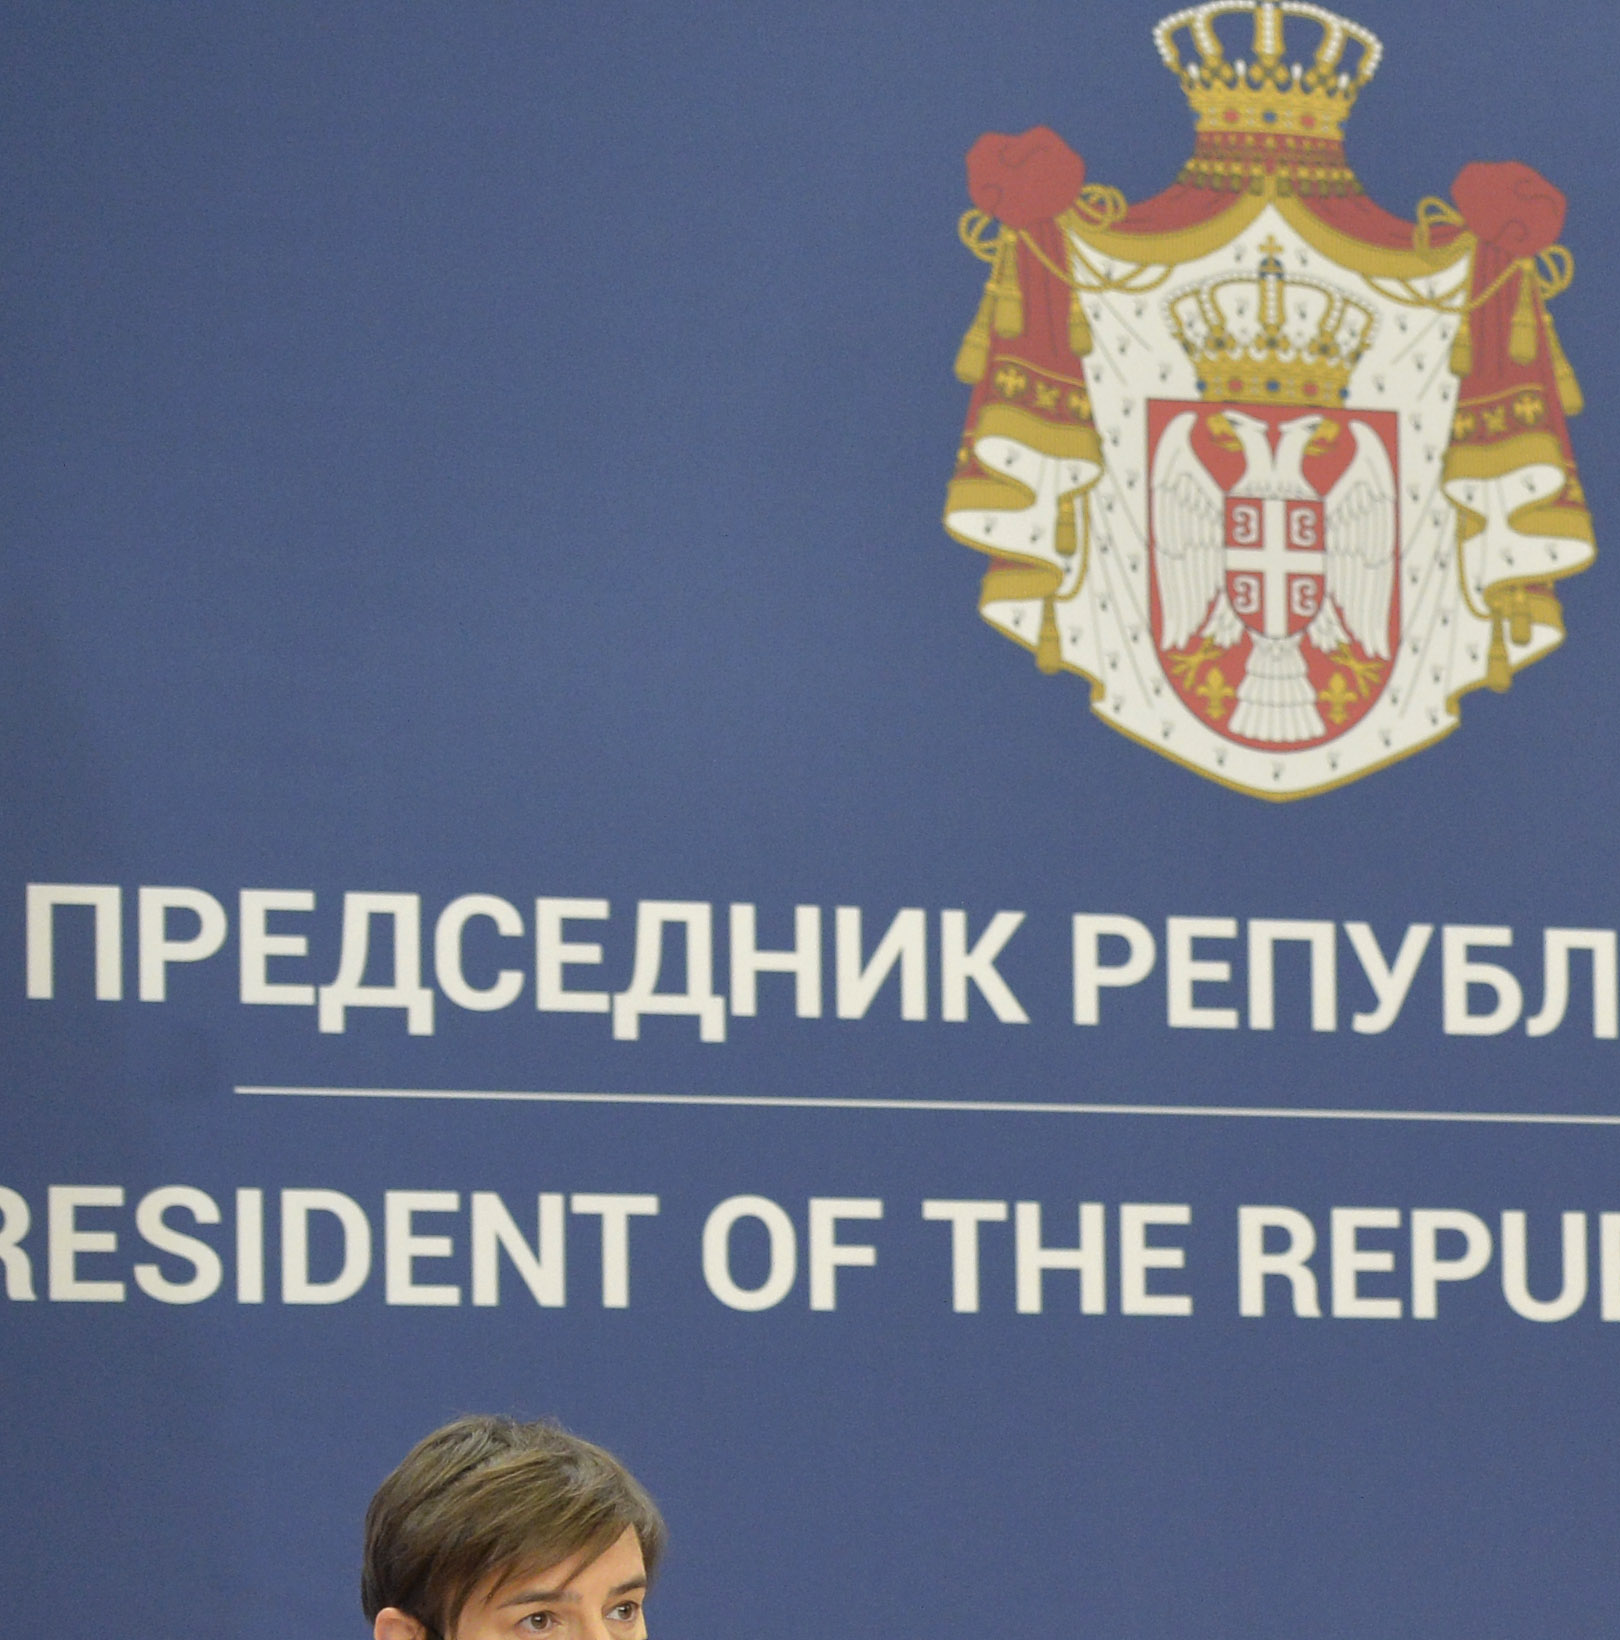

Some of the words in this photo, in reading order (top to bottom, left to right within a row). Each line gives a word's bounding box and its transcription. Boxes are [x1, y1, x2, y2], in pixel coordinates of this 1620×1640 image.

[26, 883, 1029, 1043] ПРЕДСЕДНИК
[702, 1195, 883, 1311] OF
[922, 1199, 1193, 1316] THE
